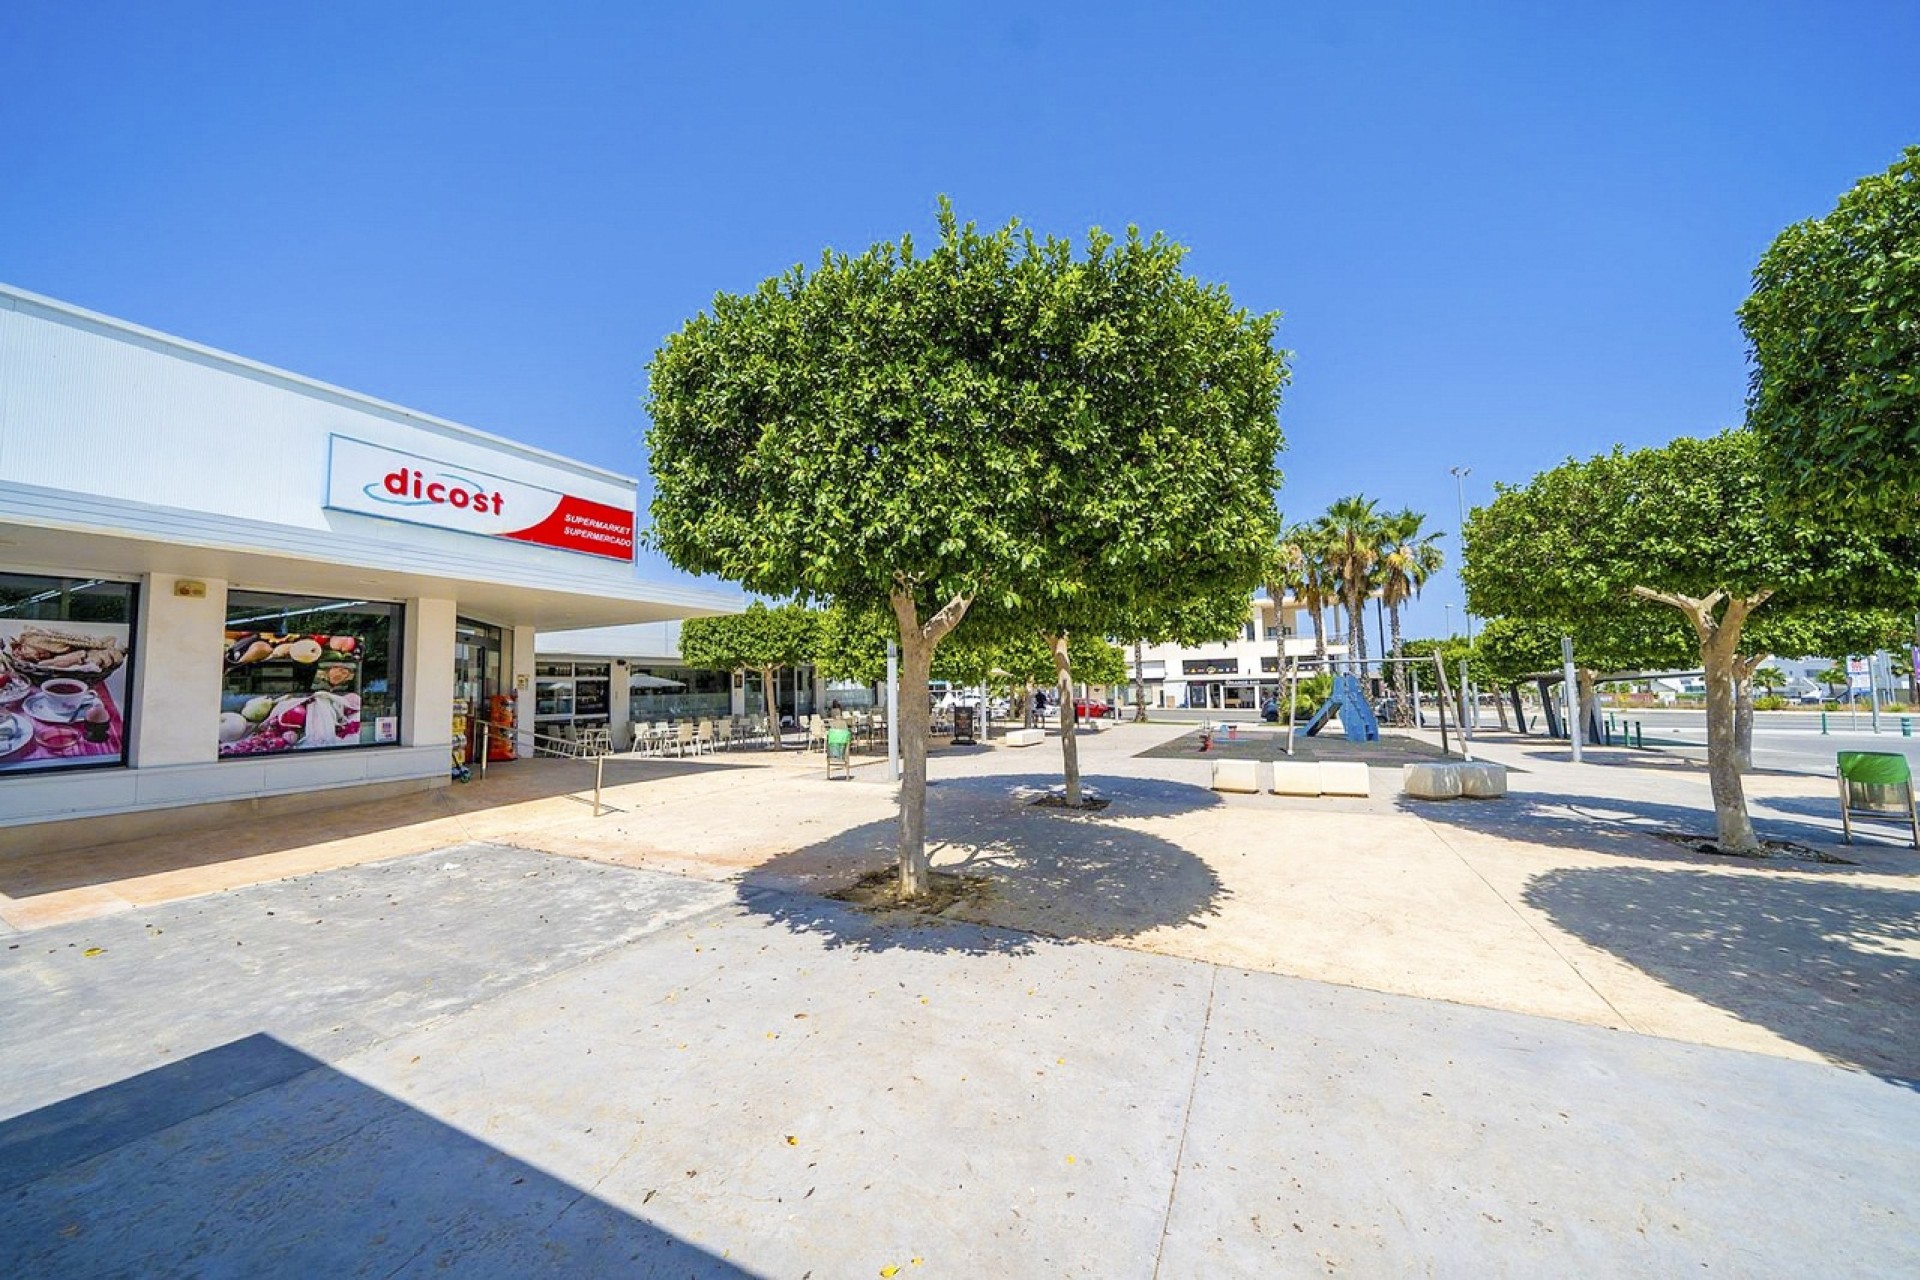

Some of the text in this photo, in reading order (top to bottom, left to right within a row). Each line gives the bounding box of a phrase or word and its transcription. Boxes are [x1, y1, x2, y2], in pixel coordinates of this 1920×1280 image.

[384, 468, 504, 515] dicost
[564, 513, 631, 535] SUPERMARKET
[564, 526, 632, 547] SUPERMERCADO
